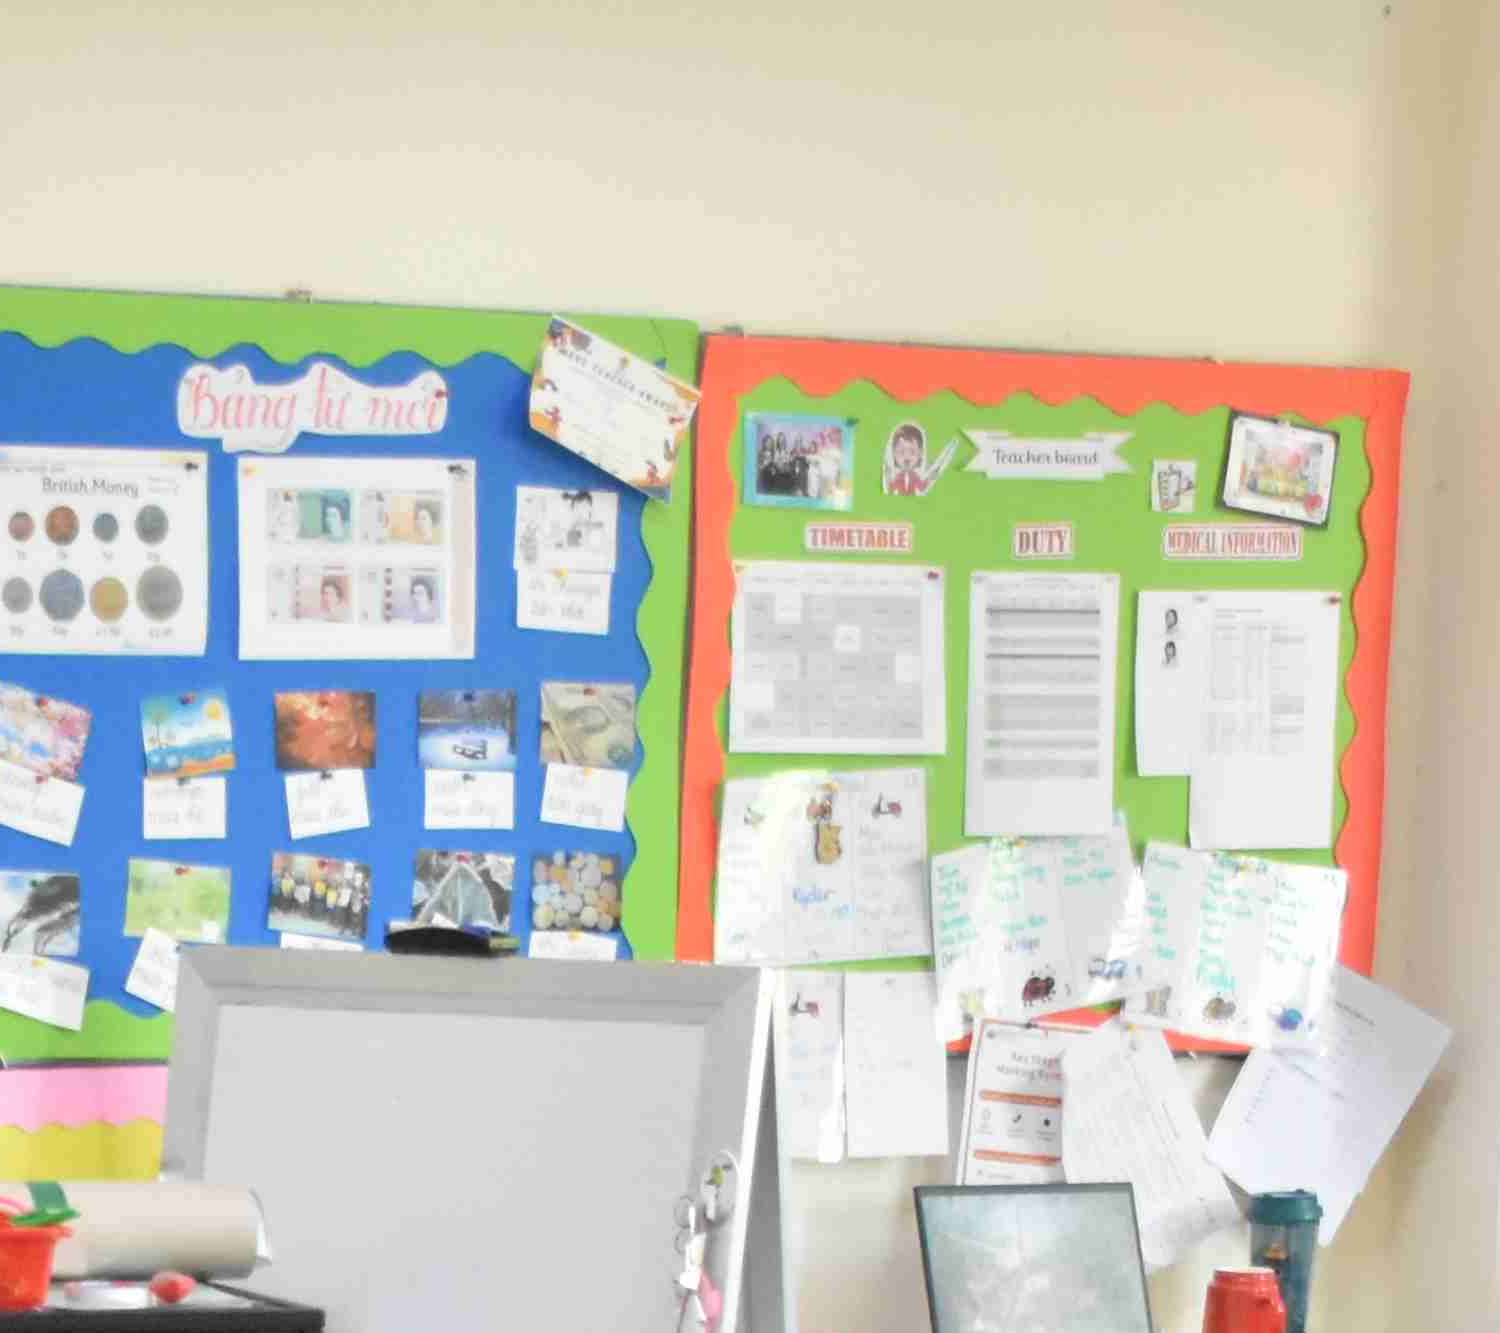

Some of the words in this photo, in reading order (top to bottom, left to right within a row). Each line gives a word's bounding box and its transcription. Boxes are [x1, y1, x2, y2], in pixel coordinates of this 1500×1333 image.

[992, 447, 1052, 466] Teacher
[1054, 448, 1098, 466] board
[41, 477, 88, 495] British
[809, 527, 910, 550] TIMETABLE
[1017, 527, 1068, 555] DUTY
[1219, 530, 1298, 555] INFORMATION
